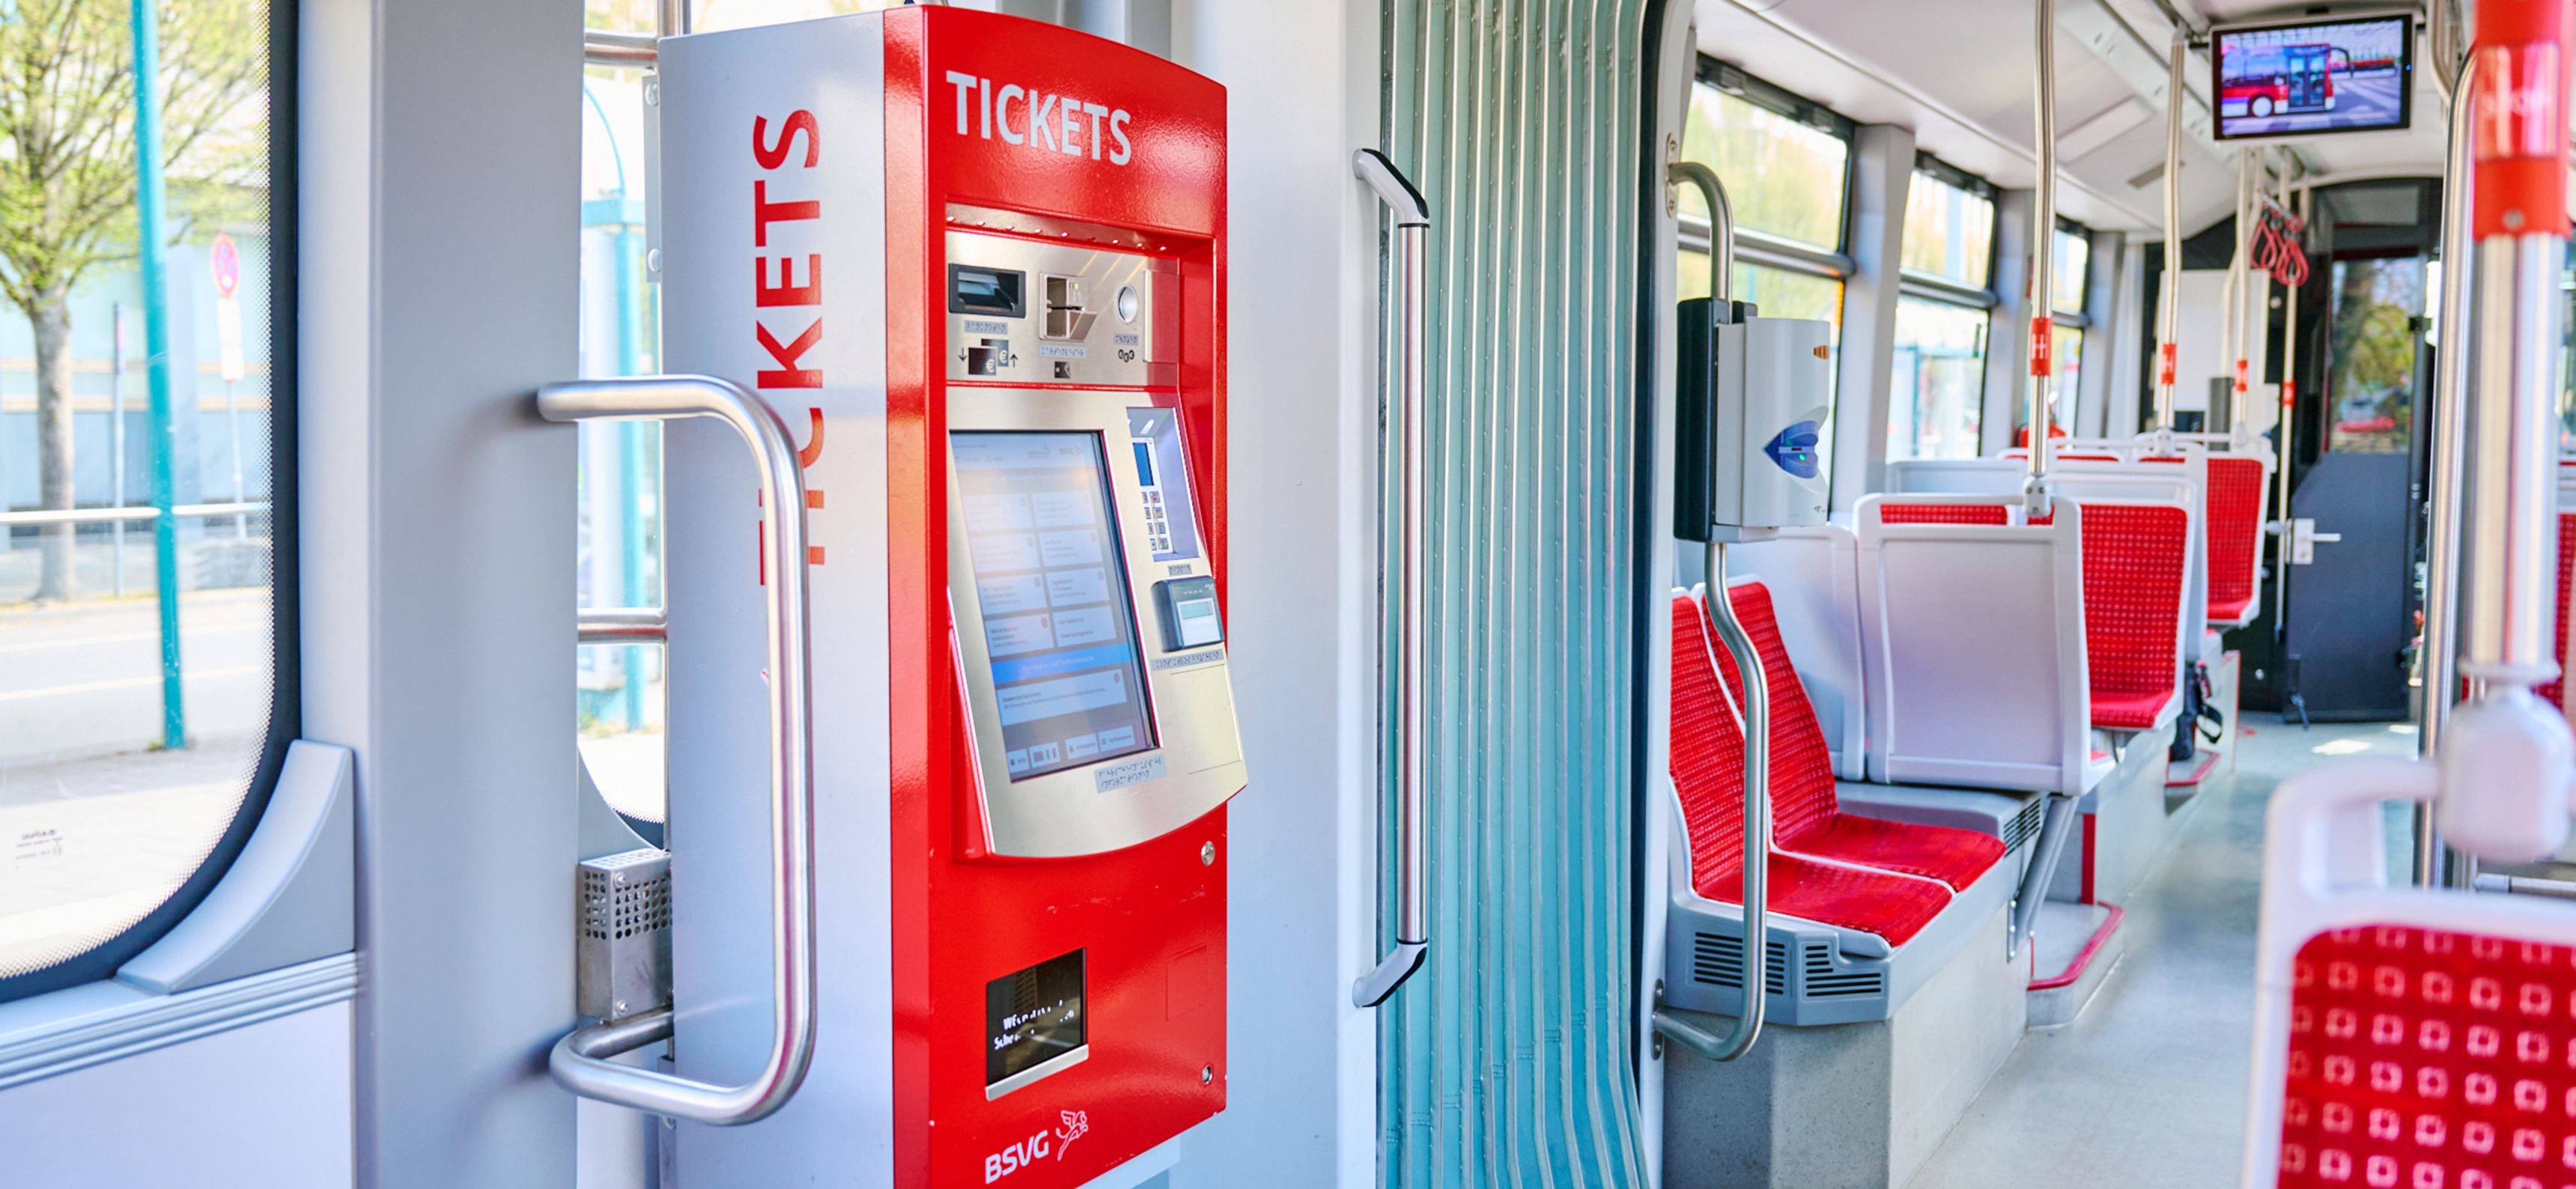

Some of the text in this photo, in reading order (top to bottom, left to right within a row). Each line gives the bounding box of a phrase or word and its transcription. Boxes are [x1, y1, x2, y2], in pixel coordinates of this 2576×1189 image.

[946, 70, 1131, 165] TICKETS
[753, 109, 825, 586] KETS
[985, 1130, 1049, 1185] BSVG
